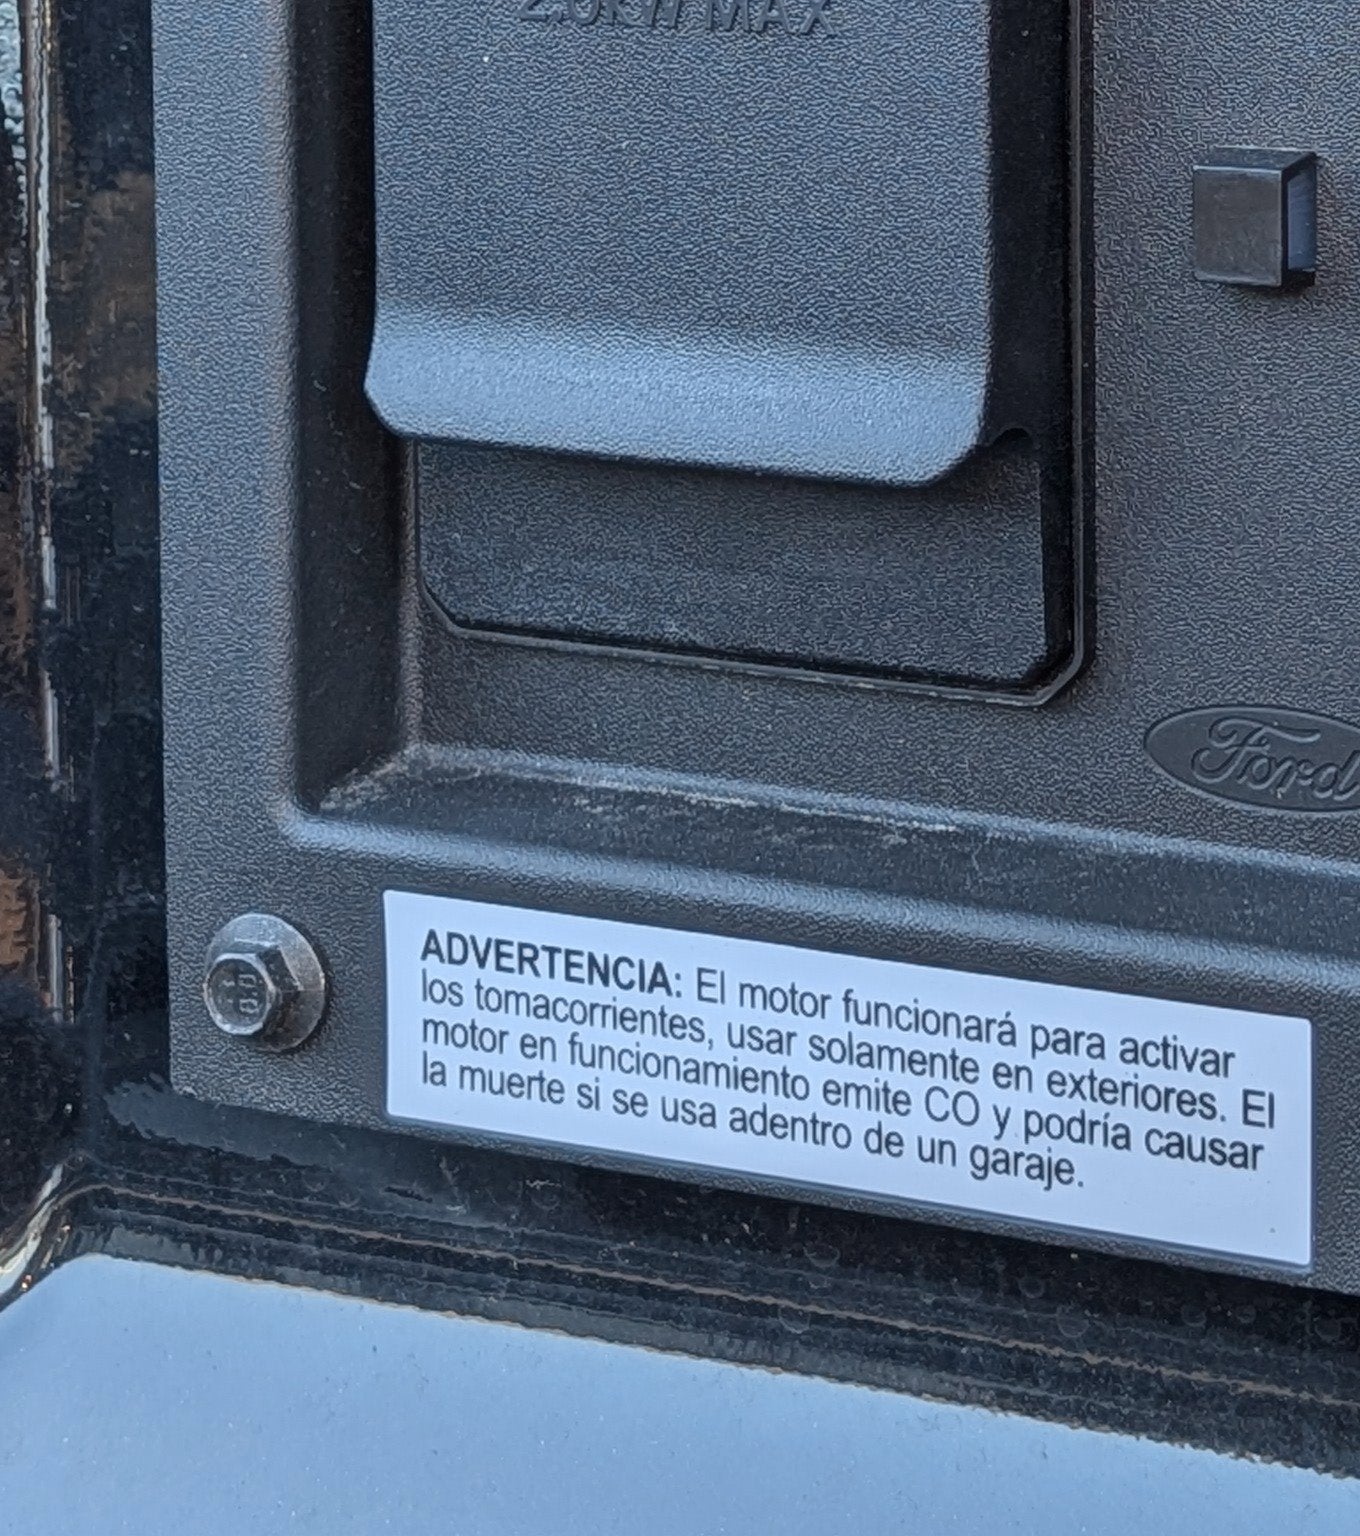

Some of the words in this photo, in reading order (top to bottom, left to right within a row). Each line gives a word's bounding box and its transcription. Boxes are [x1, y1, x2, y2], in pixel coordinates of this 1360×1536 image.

[421, 929, 681, 998] ADVERTENCIA:
[697, 967, 725, 1004] El
[739, 982, 832, 1019] motor
[842, 989, 1016, 1047] funcionará
[1031, 1024, 1105, 1060] para
[1119, 1035, 1235, 1078] activar
[422, 968, 463, 1007] los
[475, 978, 713, 1050] tomacorrientes,
[728, 1022, 797, 1056] usar
[809, 1031, 979, 1084] solamente
[993, 1062, 1032, 1093] en
[1047, 1068, 1226, 1122] exteriores.
[1242, 1089, 1274, 1129] El
[423, 1019, 509, 1054] motor
[520, 1033, 556, 1062] en
[568, 1032, 809, 1100] funcionamiento
[823, 1078, 911, 1116] emite
[925, 1086, 980, 1126] CO
[993, 1105, 1011, 1140] y
[1024, 1109, 1131, 1151] podría
[1145, 1128, 1264, 1171] causar
[423, 1051, 446, 1086] la
[460, 1065, 565, 1104] muerte
[577, 1077, 600, 1111] si
[613, 1089, 648, 1117] se
[661, 1097, 716, 1129] usa
[729, 1102, 852, 1149] adentro
[864, 1121, 904, 1158] de
[918, 1136, 956, 1167] un
[970, 1145, 1083, 1191] garaje.
